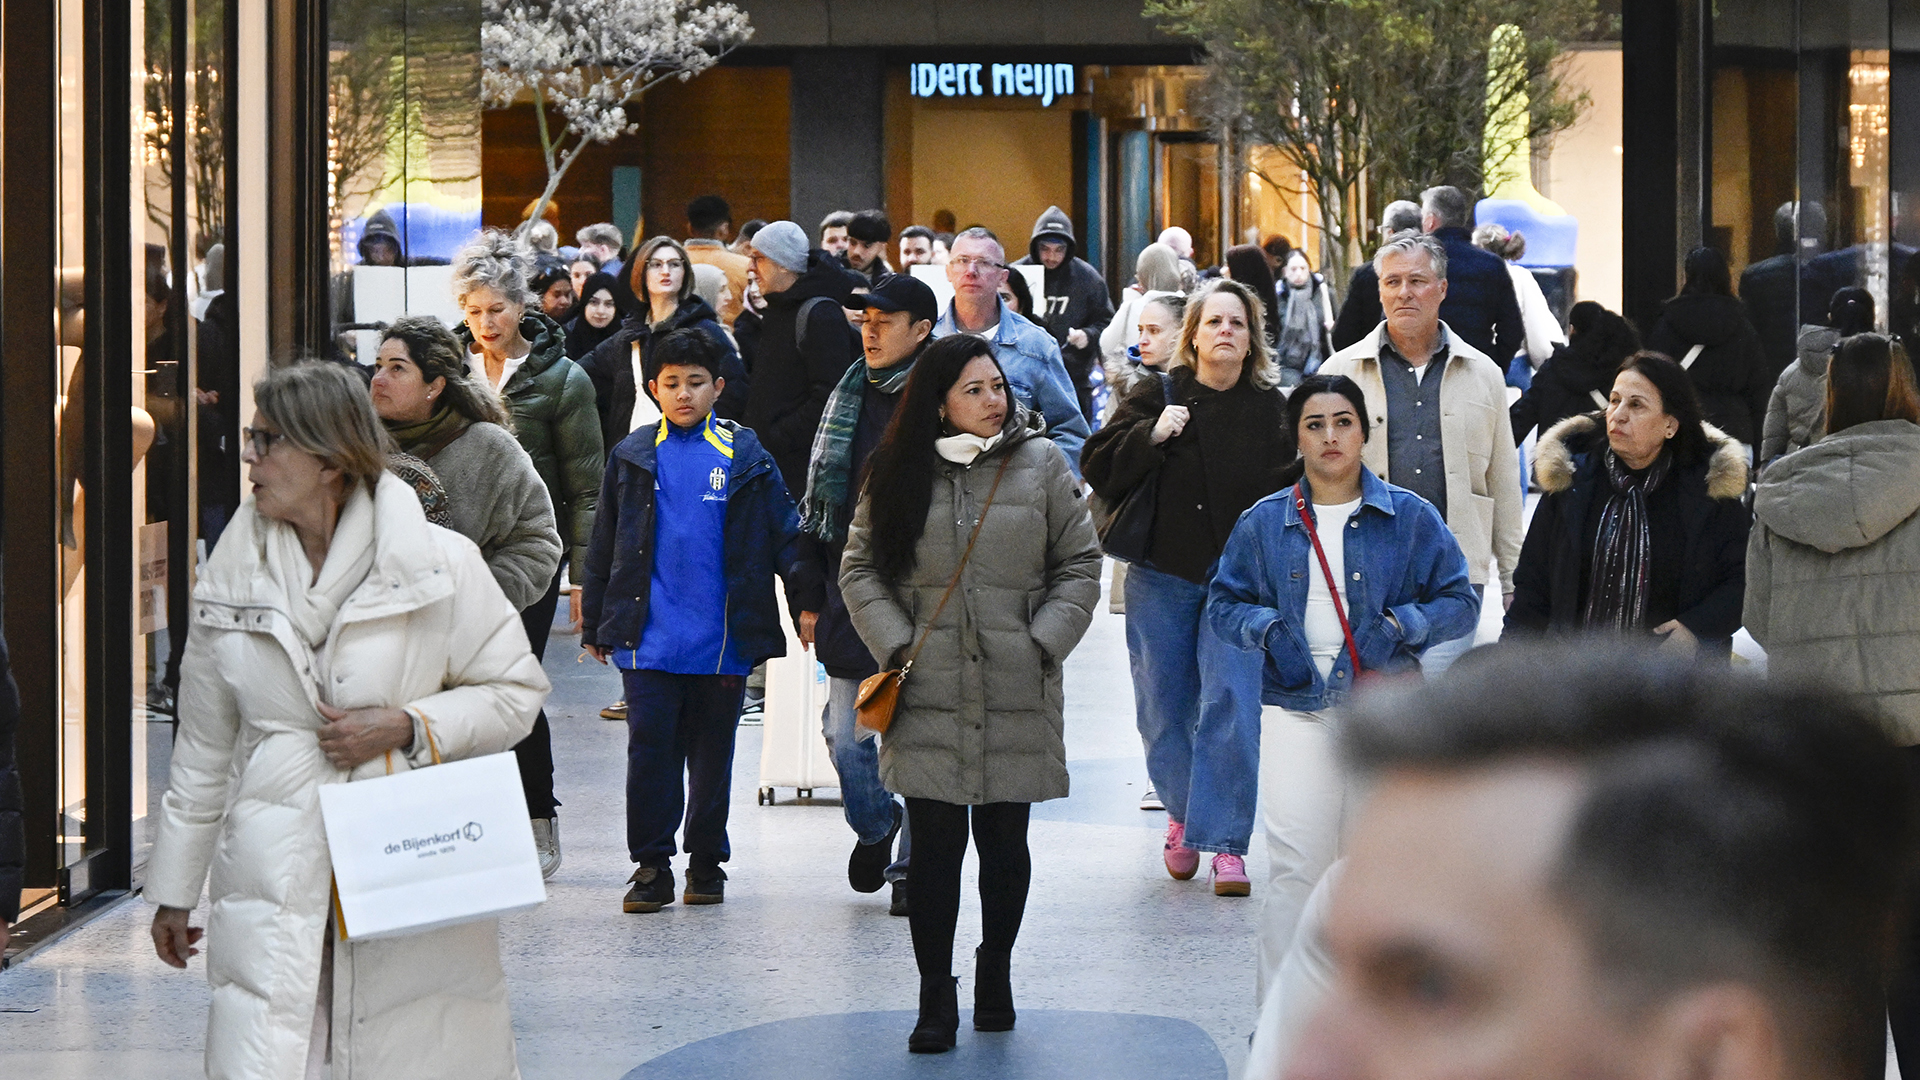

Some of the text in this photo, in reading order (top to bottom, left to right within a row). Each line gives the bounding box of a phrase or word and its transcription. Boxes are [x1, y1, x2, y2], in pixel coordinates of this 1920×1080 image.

[1047, 296, 1070, 315] 77
[384, 828, 461, 855] de Bijenkorf
